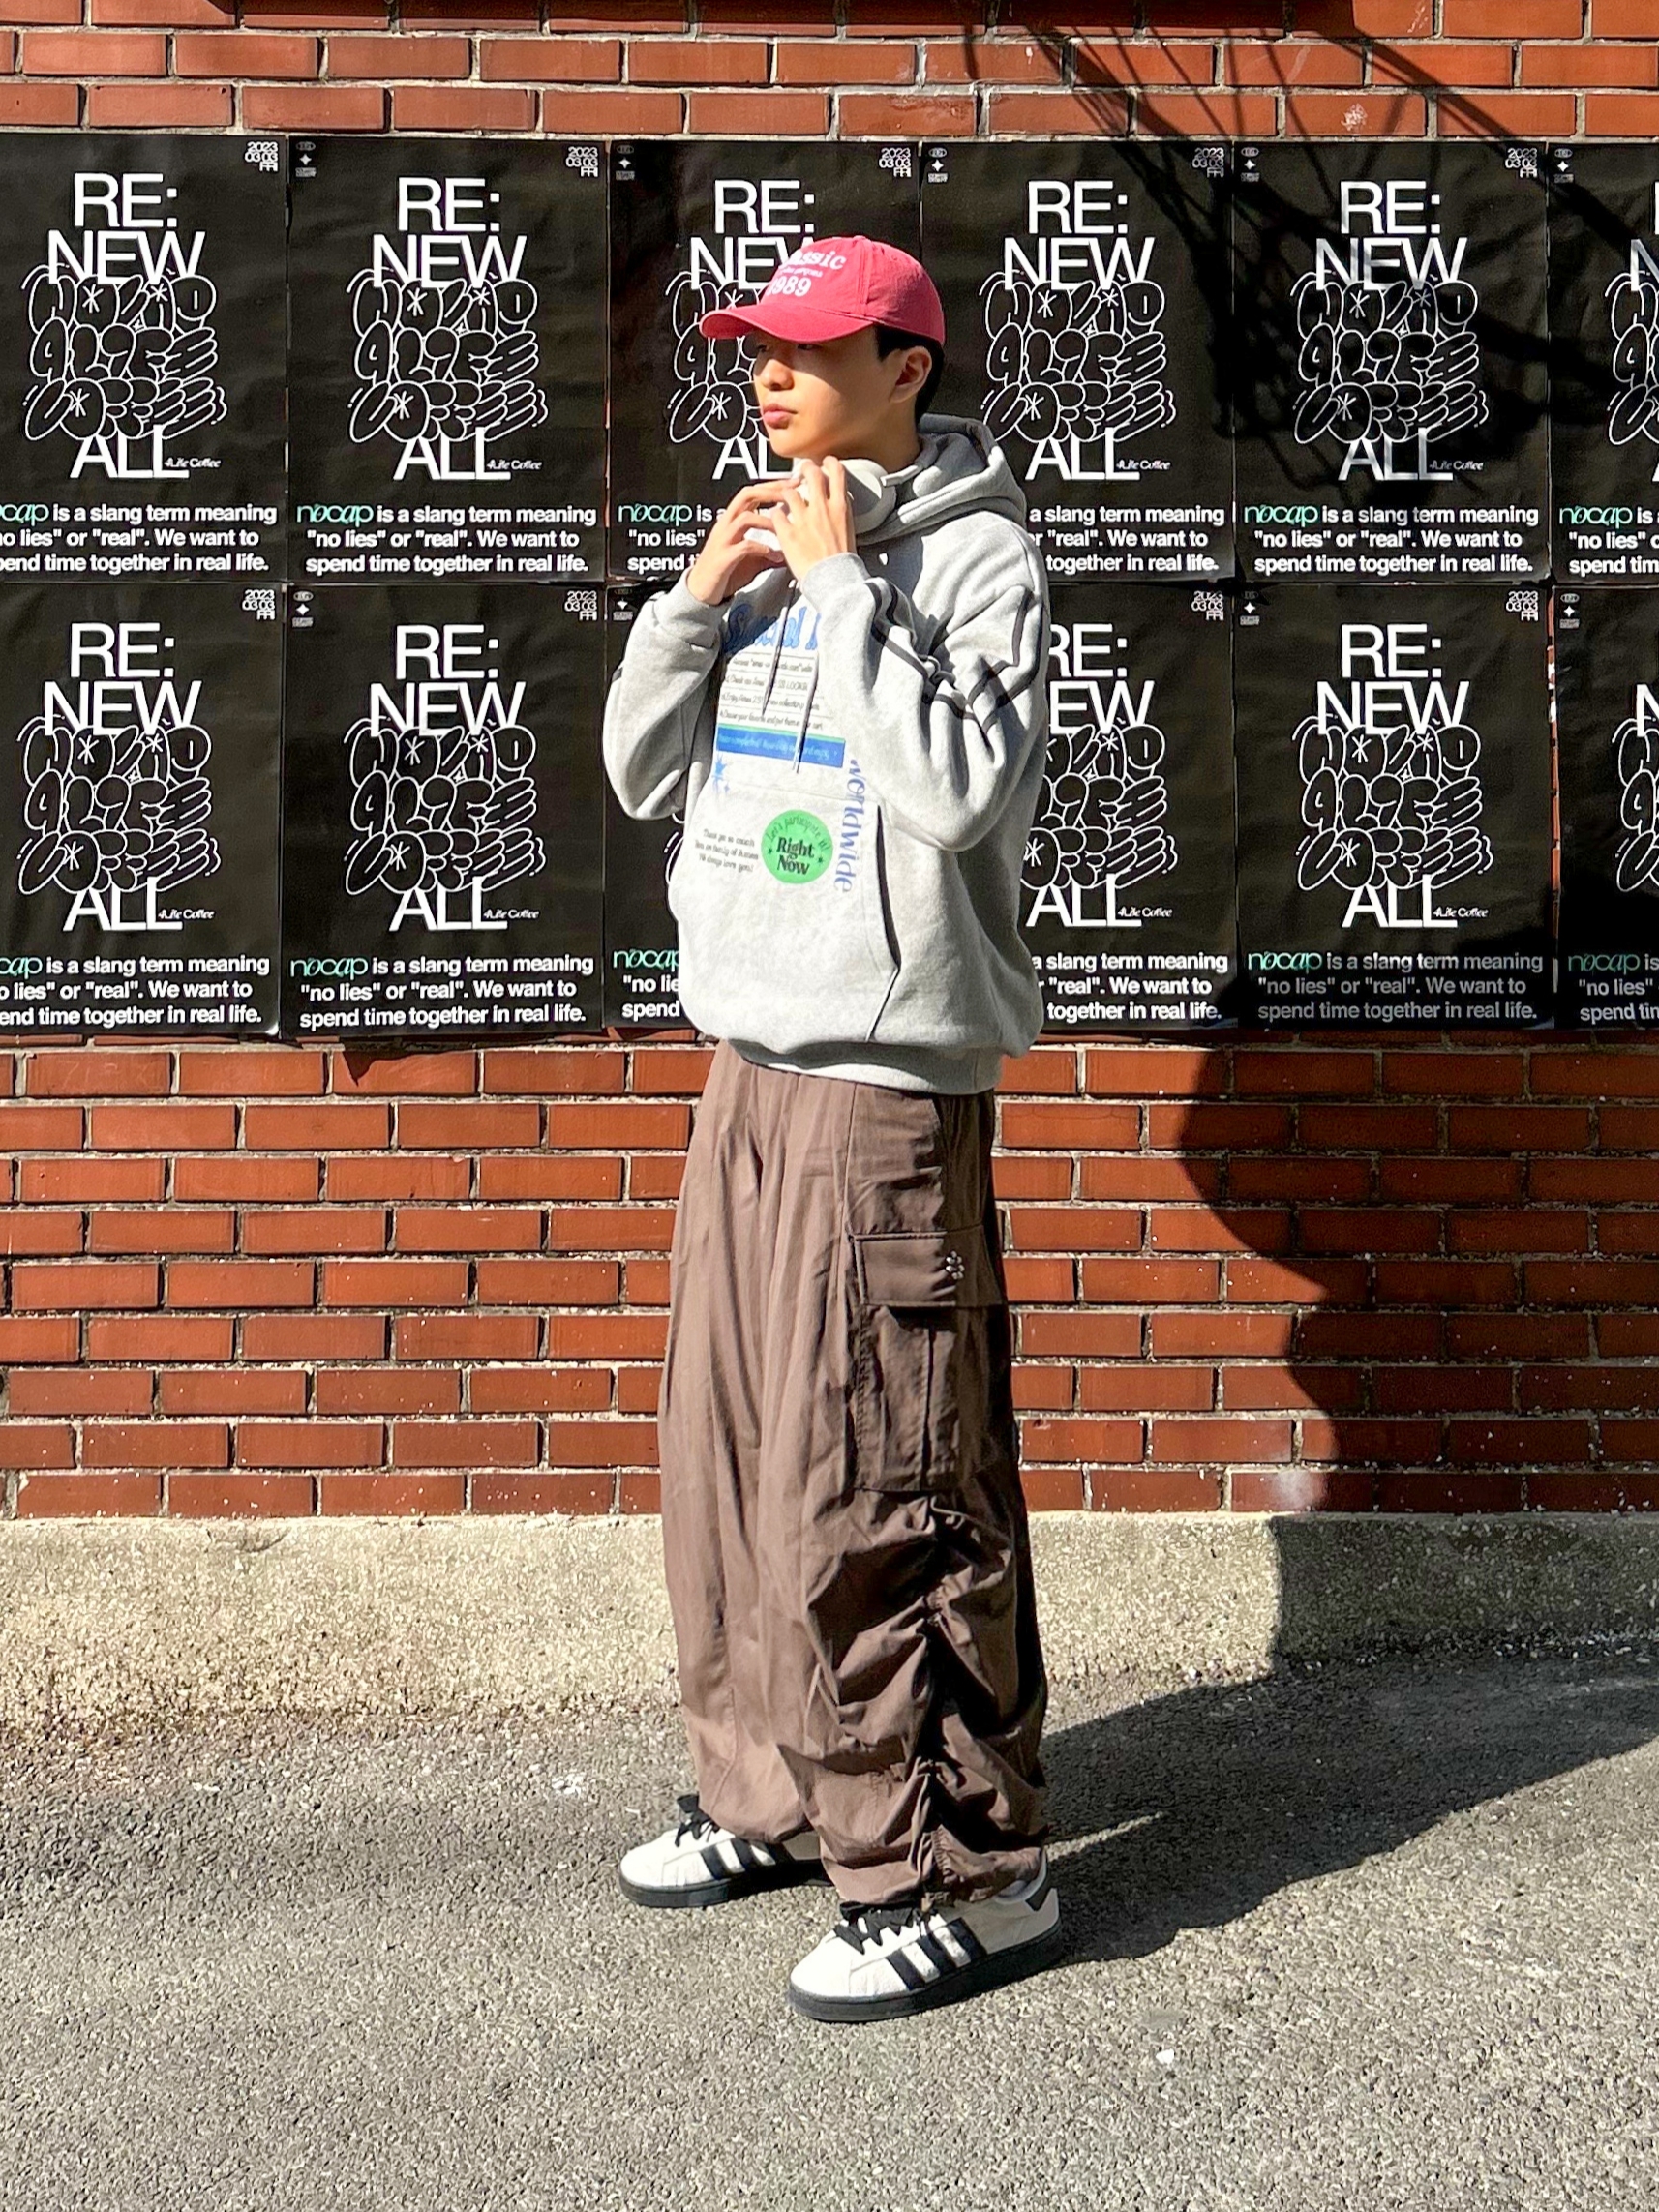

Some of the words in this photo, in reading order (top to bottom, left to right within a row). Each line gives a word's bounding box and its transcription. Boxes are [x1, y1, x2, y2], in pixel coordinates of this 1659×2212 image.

[568, 146, 598, 158] 2023
[74, 173, 178, 227] RE:
[398, 178, 500, 231] RE:
[715, 180, 815, 233] RE:
[1028, 181, 1129, 233] RE:
[1340, 181, 1440, 234] RE:
[47, 231, 205, 284] NEW
[373, 235, 527, 288] NEW
[1004, 237, 1154, 290] NEW
[1315, 238, 1466, 290] NEW
[69, 425, 190, 478] ALL
[393, 427, 511, 480] ALL
[711, 438, 793, 480] AL
[1024, 428, 1140, 480] ALL
[1338, 428, 1454, 481] ALL
[297, 504, 374, 527] nocap
[377, 505, 394, 523] is
[397, 509, 409, 523] a
[413, 505, 465, 526] slang
[468, 506, 511, 523] term
[516, 505, 596, 526] meaning
[308, 530, 341, 547] "no
[345, 530, 386, 547] lies"
[390, 533, 411, 547] or
[416, 530, 472, 547] "real".
[477, 530, 507, 547] We
[511, 531, 557, 547] want
[559, 531, 579, 547] to
[618, 504, 692, 526] nocap
[697, 505, 712, 522] is
[629, 529, 661, 546] "no
[666, 529, 705, 546] lies"
[1029, 509, 1041, 522] a
[1044, 505, 1095, 525] slang
[1100, 506, 1141, 522] term
[1145, 505, 1224, 526] meaning
[1047, 529, 1103, 546] "real".
[1107, 529, 1137, 547] We
[1140, 531, 1186, 547] want
[1189, 531, 1208, 547] to
[1245, 505, 1318, 527] nocap
[1322, 505, 1339, 523] is
[1342, 510, 1353, 523] a
[1358, 506, 1407, 526] slang
[1413, 507, 1455, 523] term
[1460, 505, 1538, 526] meaning
[1254, 530, 1287, 547] "no
[1292, 530, 1331, 547] lies"
[1336, 534, 1356, 547] or
[1361, 530, 1416, 547] "real".
[1421, 530, 1452, 547] We
[1455, 531, 1499, 547] want
[1503, 531, 1523, 547] to
[1559, 506, 1633, 528] nocap
[1637, 507, 1653, 523] is
[306, 555, 365, 576] spend
[369, 554, 410, 572] time
[413, 554, 493, 576] together
[497, 554, 513, 571] in
[518, 554, 552, 572] real
[557, 554, 588, 571] life.
[628, 554, 684, 575] spend
[1046, 554, 1123, 575] together
[1127, 554, 1143, 570] in
[1148, 554, 1182, 571] real
[1187, 554, 1219, 571] life.
[1255, 555, 1312, 576] spend
[1315, 554, 1356, 572] time
[1359, 555, 1436, 576] together
[1440, 554, 1458, 571] in
[1463, 554, 1495, 572] real
[1501, 554, 1533, 572] life.
[567, 590, 597, 601] 2023
[70, 623, 174, 677] RE:
[396, 625, 499, 678] RE:
[1341, 624, 1442, 677] RE:
[44, 681, 200, 735] NEW
[370, 682, 526, 736] NEW
[1049, 680, 1155, 734] EW
[1317, 681, 1469, 734] NEW
[776, 837, 815, 859] Right
[776, 854, 810, 875] Now
[63, 877, 183, 931] ALL
[389, 877, 508, 931] ALL
[1025, 874, 1142, 927] ALL
[1341, 874, 1458, 927] ALL
[291, 958, 368, 980] nocap
[373, 957, 388, 974] is
[393, 961, 405, 973] a
[409, 956, 461, 977] slang
[465, 957, 508, 972] term
[513, 954, 593, 975] meaning
[1249, 951, 1322, 973] nocap
[1327, 952, 1342, 969] is
[1347, 956, 1357, 969] a
[1363, 952, 1412, 972] slang
[1417, 953, 1459, 969] term
[1464, 952, 1543, 972] meaning
[1258, 977, 1290, 994] "no
[1296, 977, 1335, 994] lies"
[1341, 981, 1360, 993] or
[1365, 977, 1420, 994] "real".
[1426, 977, 1456, 994] We
[1459, 978, 1504, 994] want
[1508, 978, 1526, 994] to
[301, 985, 335, 1001] "no
[340, 983, 380, 1001] lies"
[386, 985, 407, 999] or
[411, 981, 468, 999] "real".
[473, 980, 504, 998] We
[507, 980, 554, 997] want
[557, 980, 576, 996] to
[1258, 1001, 1314, 1023] spend
[1319, 1001, 1360, 1018] time
[1364, 1001, 1440, 1022] together
[1445, 1001, 1462, 1018] in
[1467, 1001, 1499, 1018] real
[1505, 1001, 1537, 1018] life.
[300, 1008, 359, 1031] spend
[364, 1008, 406, 1025] time
[408, 1006, 489, 1029] together
[493, 1005, 509, 1023] in
[515, 1004, 549, 1022] real
[554, 1003, 586, 1021] life.
